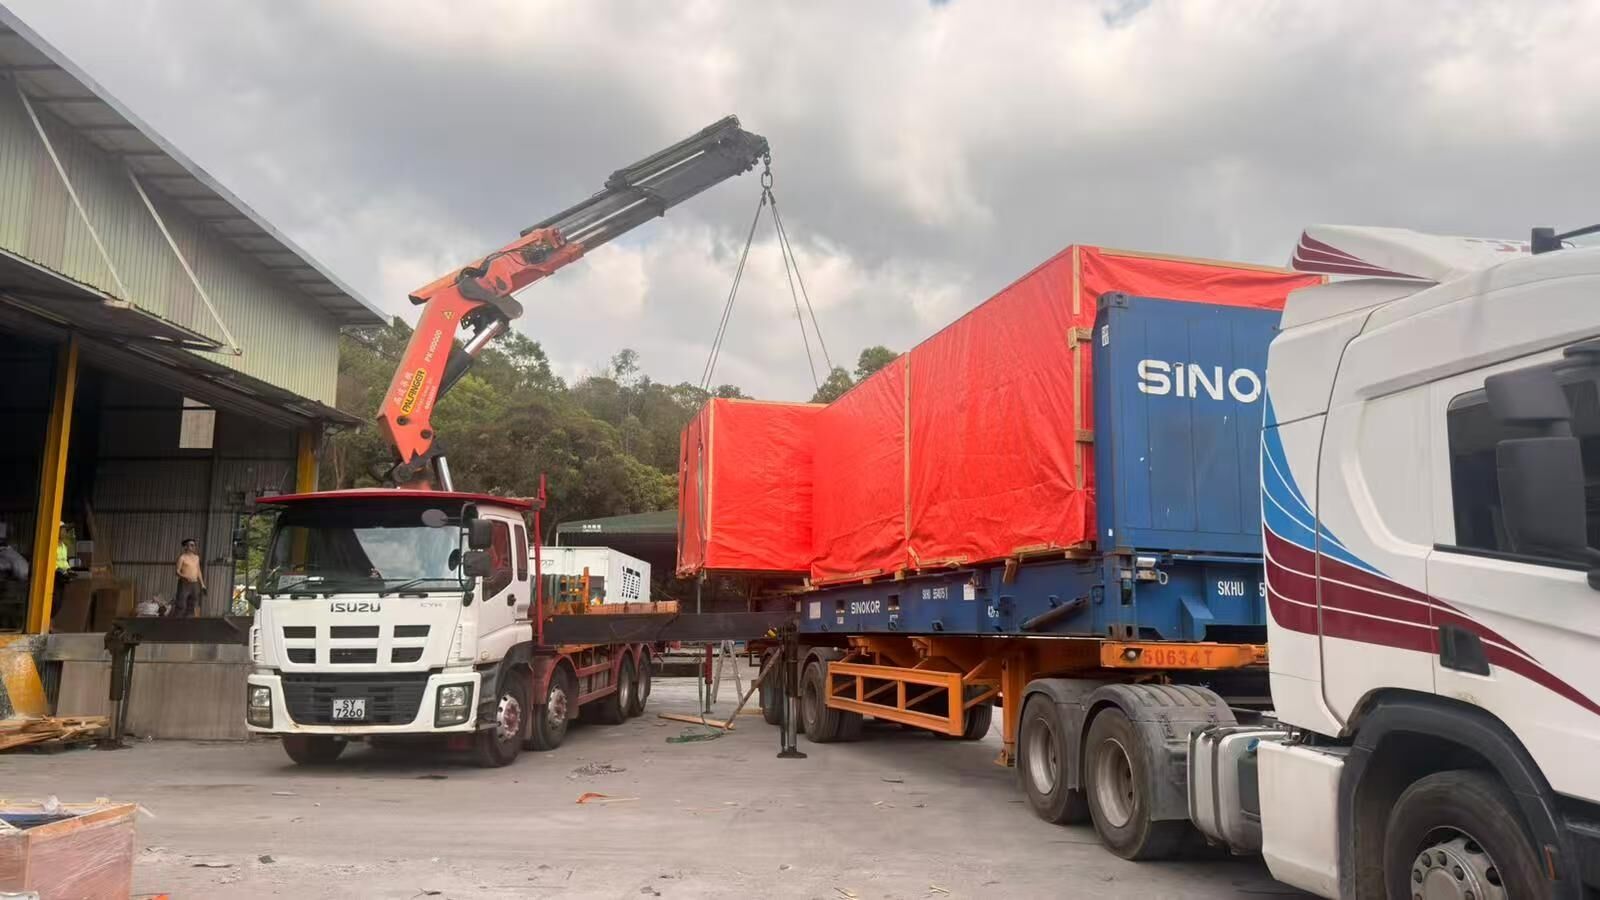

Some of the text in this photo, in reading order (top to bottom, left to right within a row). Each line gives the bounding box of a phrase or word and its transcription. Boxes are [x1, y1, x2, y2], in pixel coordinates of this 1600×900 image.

[1137, 359, 1263, 403] SINO
[401, 370, 425, 413] PALFINGER
[1217, 580, 1244, 596] SKHU
[330, 602, 381, 613] ISUZU
[851, 600, 881, 615] SINOKOR
[1143, 649, 1213, 665] 50634T
[342, 700, 356, 709] SY
[335, 708, 363, 718] 7260
